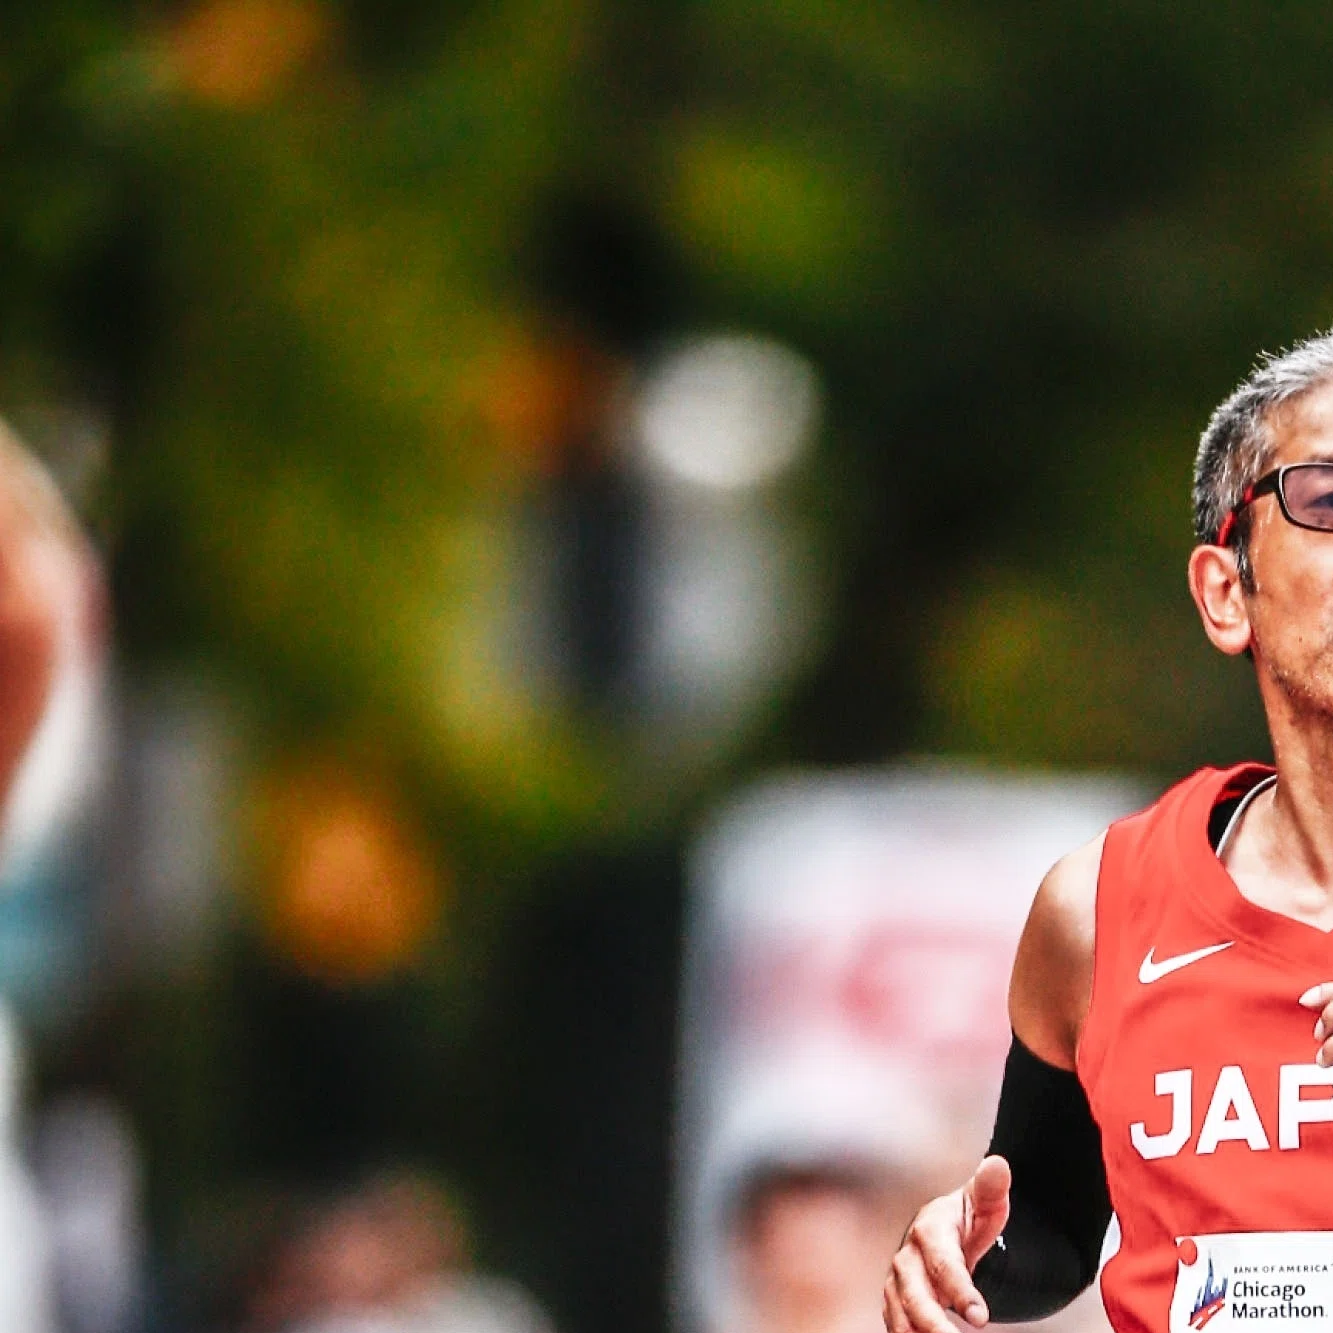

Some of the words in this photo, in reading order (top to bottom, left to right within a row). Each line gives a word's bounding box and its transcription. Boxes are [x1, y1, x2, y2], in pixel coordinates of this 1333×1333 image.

[1233, 1266, 1258, 1274] BANK
[1262, 1265, 1275, 1274] OF
[1279, 1264, 1329, 1273] AMERICA
[1233, 1281, 1306, 1302] Chicago
